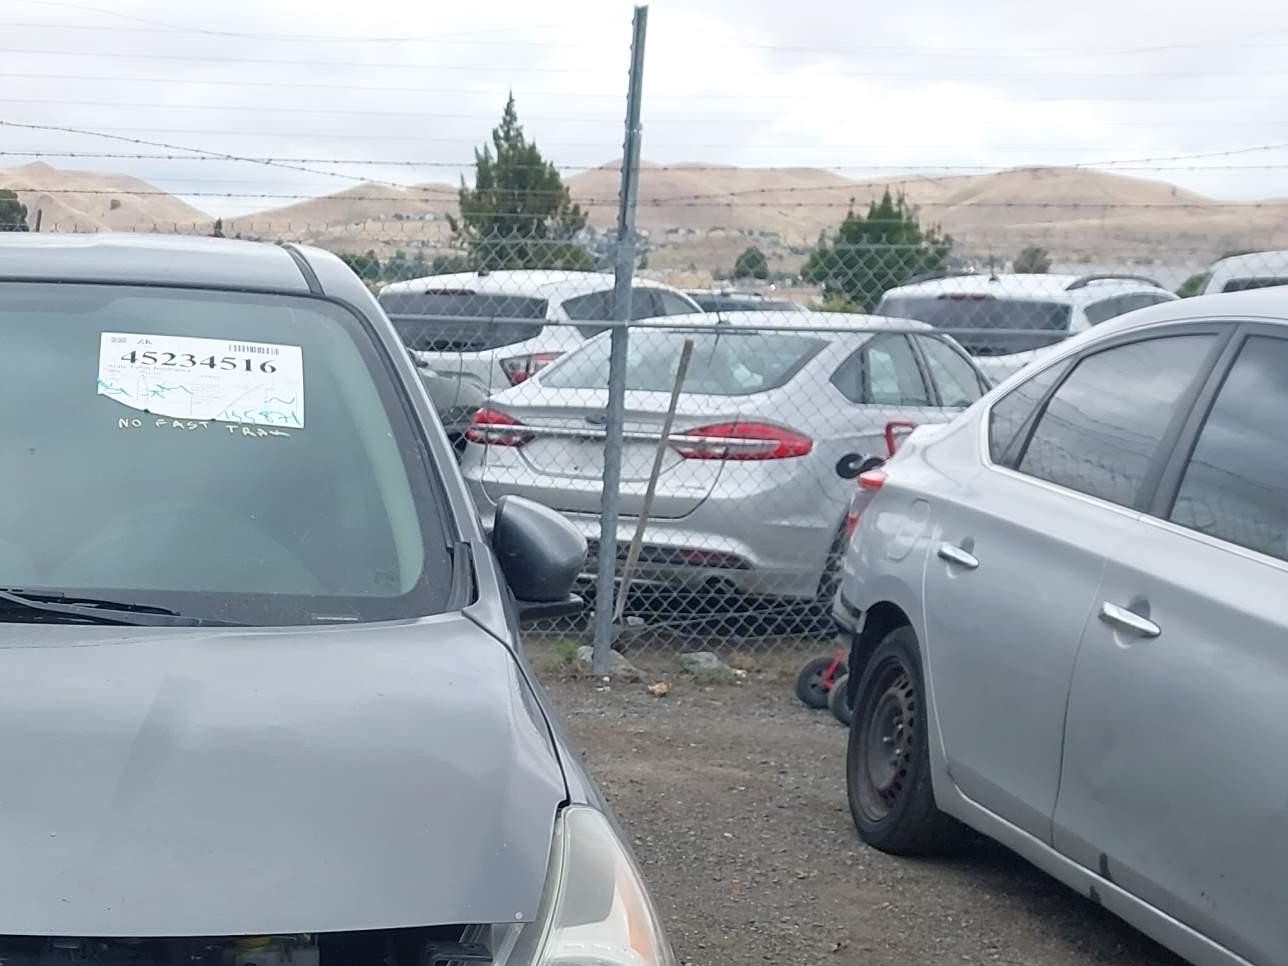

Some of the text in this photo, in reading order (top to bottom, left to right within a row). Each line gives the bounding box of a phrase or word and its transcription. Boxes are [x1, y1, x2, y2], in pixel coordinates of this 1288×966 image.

[120, 350, 277, 374] 45234516
[118, 418, 142, 429] NO
[155, 419, 210, 430] FAST
